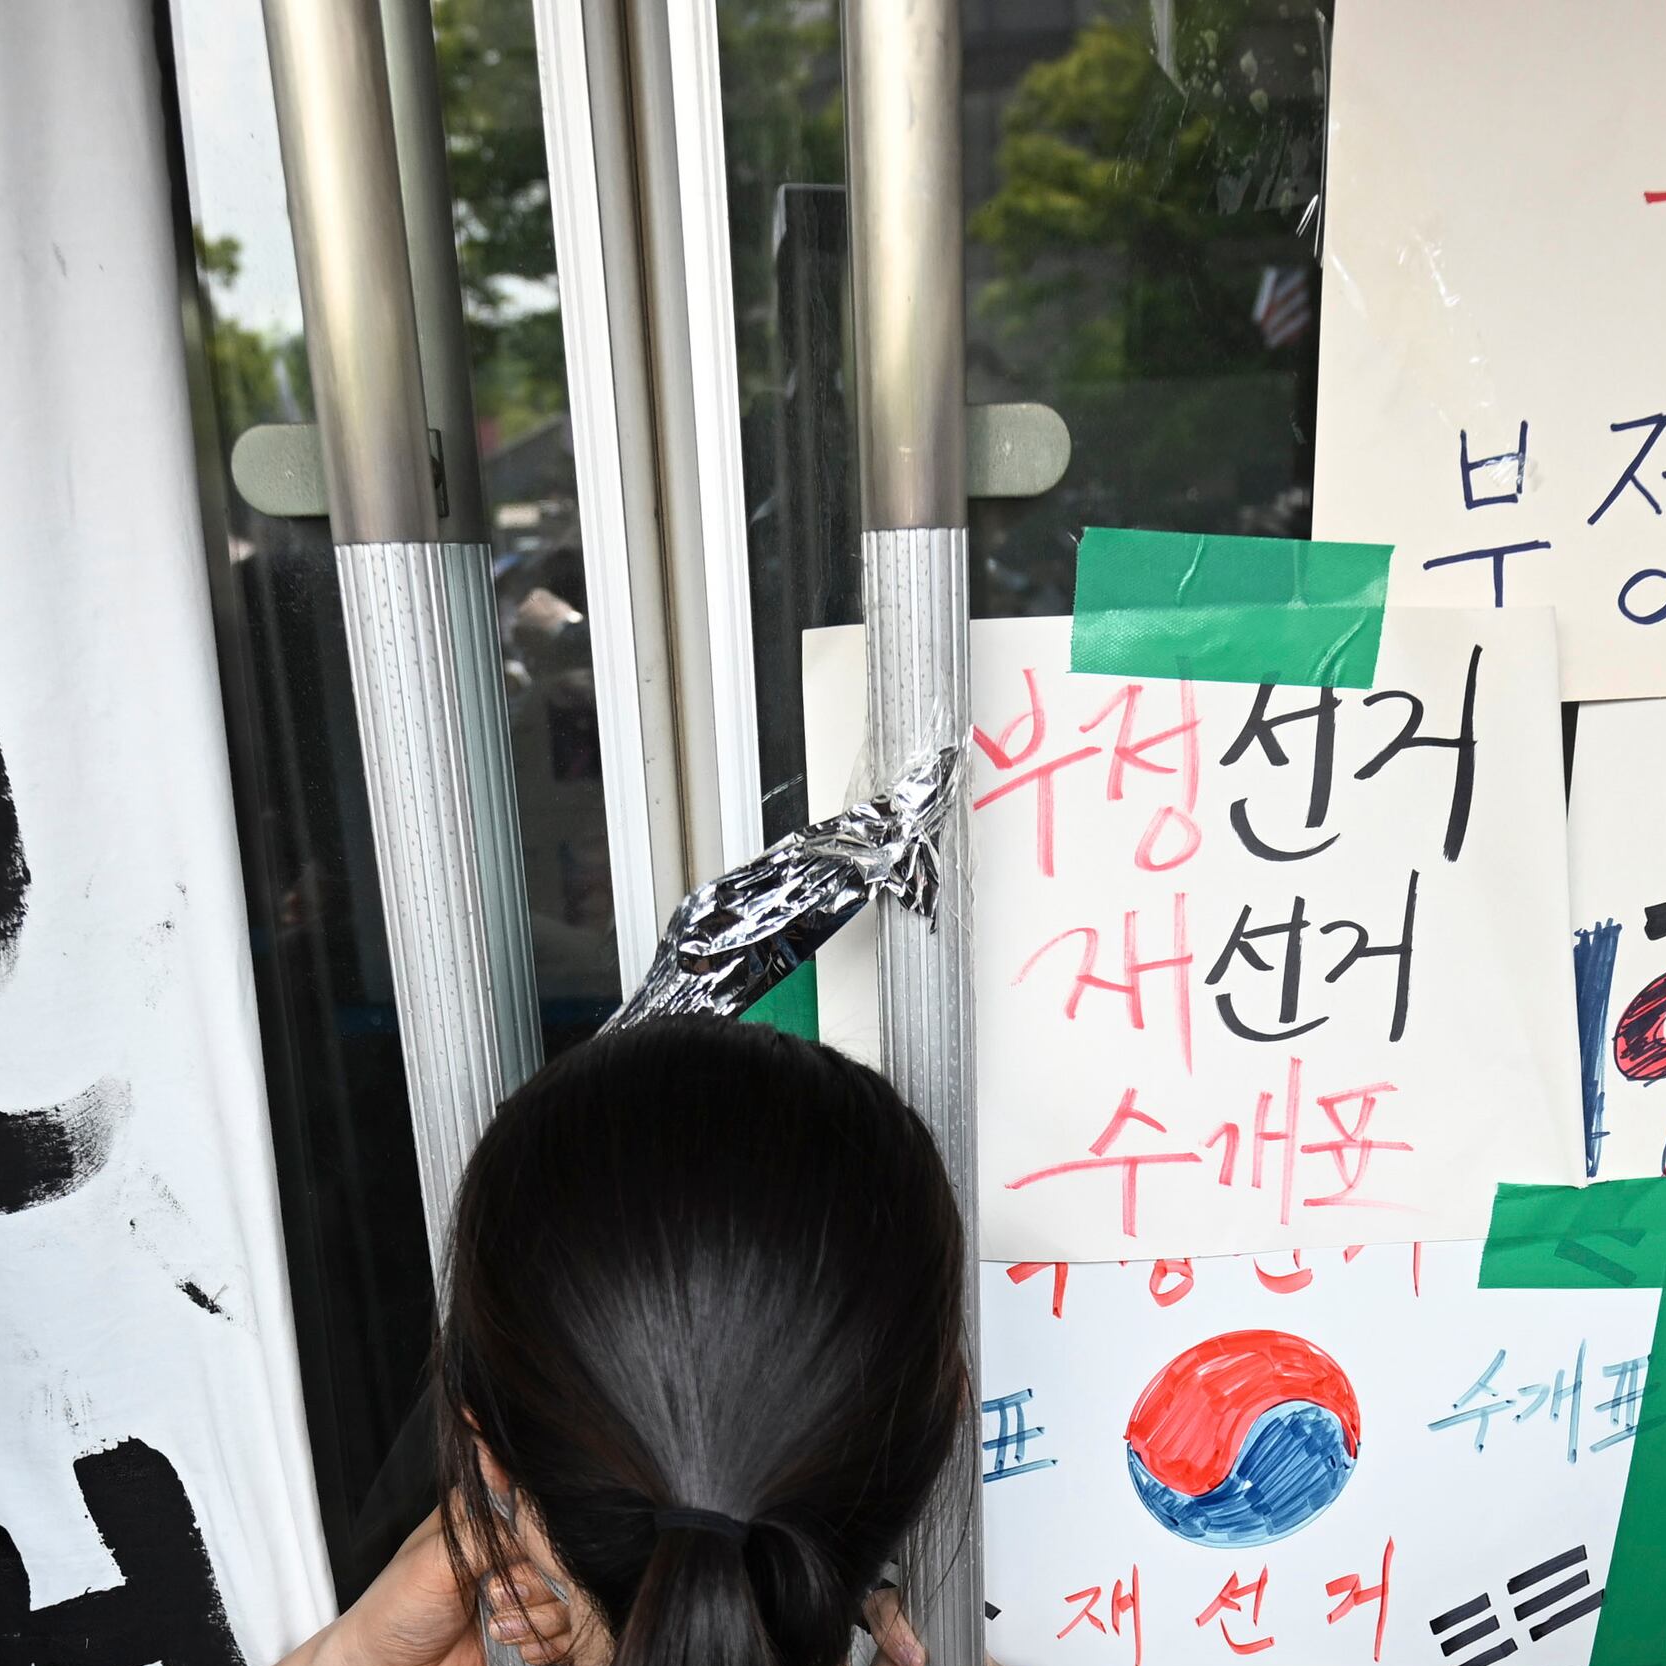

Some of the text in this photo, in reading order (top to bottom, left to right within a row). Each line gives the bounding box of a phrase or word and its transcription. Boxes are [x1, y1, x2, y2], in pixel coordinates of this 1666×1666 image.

[970, 644, 1485, 877] 부정선거
[1014, 871, 1420, 1075] 재선거
[1005, 1056, 1412, 1237] 수개표
[1429, 1340, 1663, 1463] 수개표
